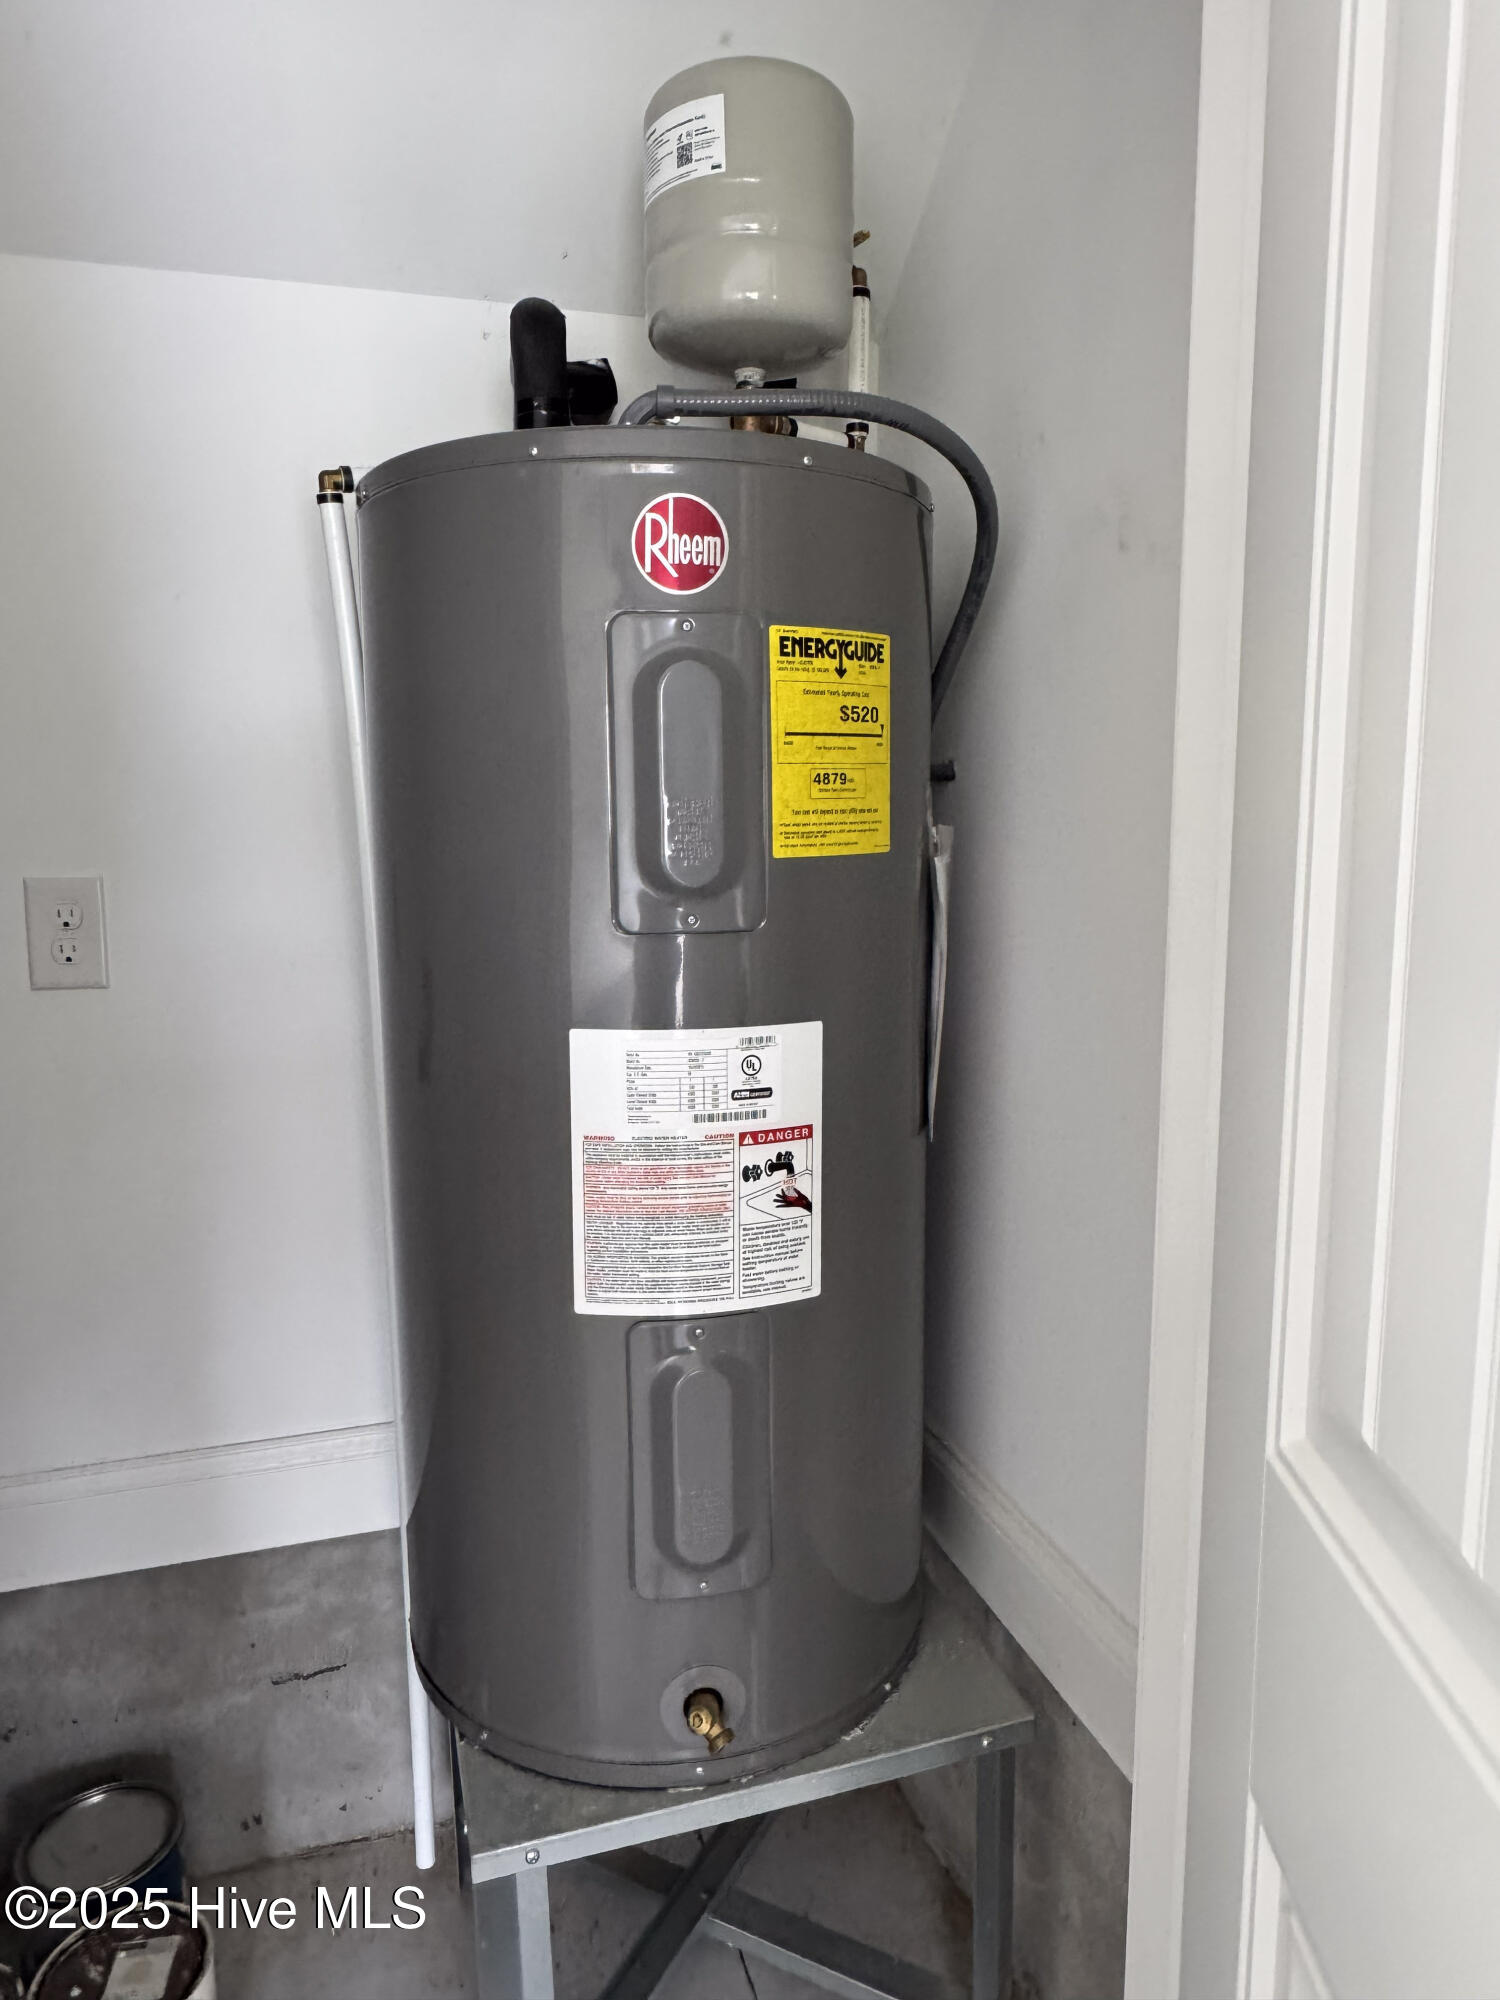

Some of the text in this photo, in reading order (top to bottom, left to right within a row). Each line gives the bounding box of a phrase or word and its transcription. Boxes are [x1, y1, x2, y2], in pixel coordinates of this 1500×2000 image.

[644, 497, 721, 578] Rheem
[779, 635, 885, 664] ENERGYGUIDE
[839, 704, 879, 723] $520
[813, 772, 847, 785] 4879
[746, 1059, 757, 1072] UL
[704, 1132, 735, 1140] CAUTION
[758, 1128, 809, 1143] DANGER
